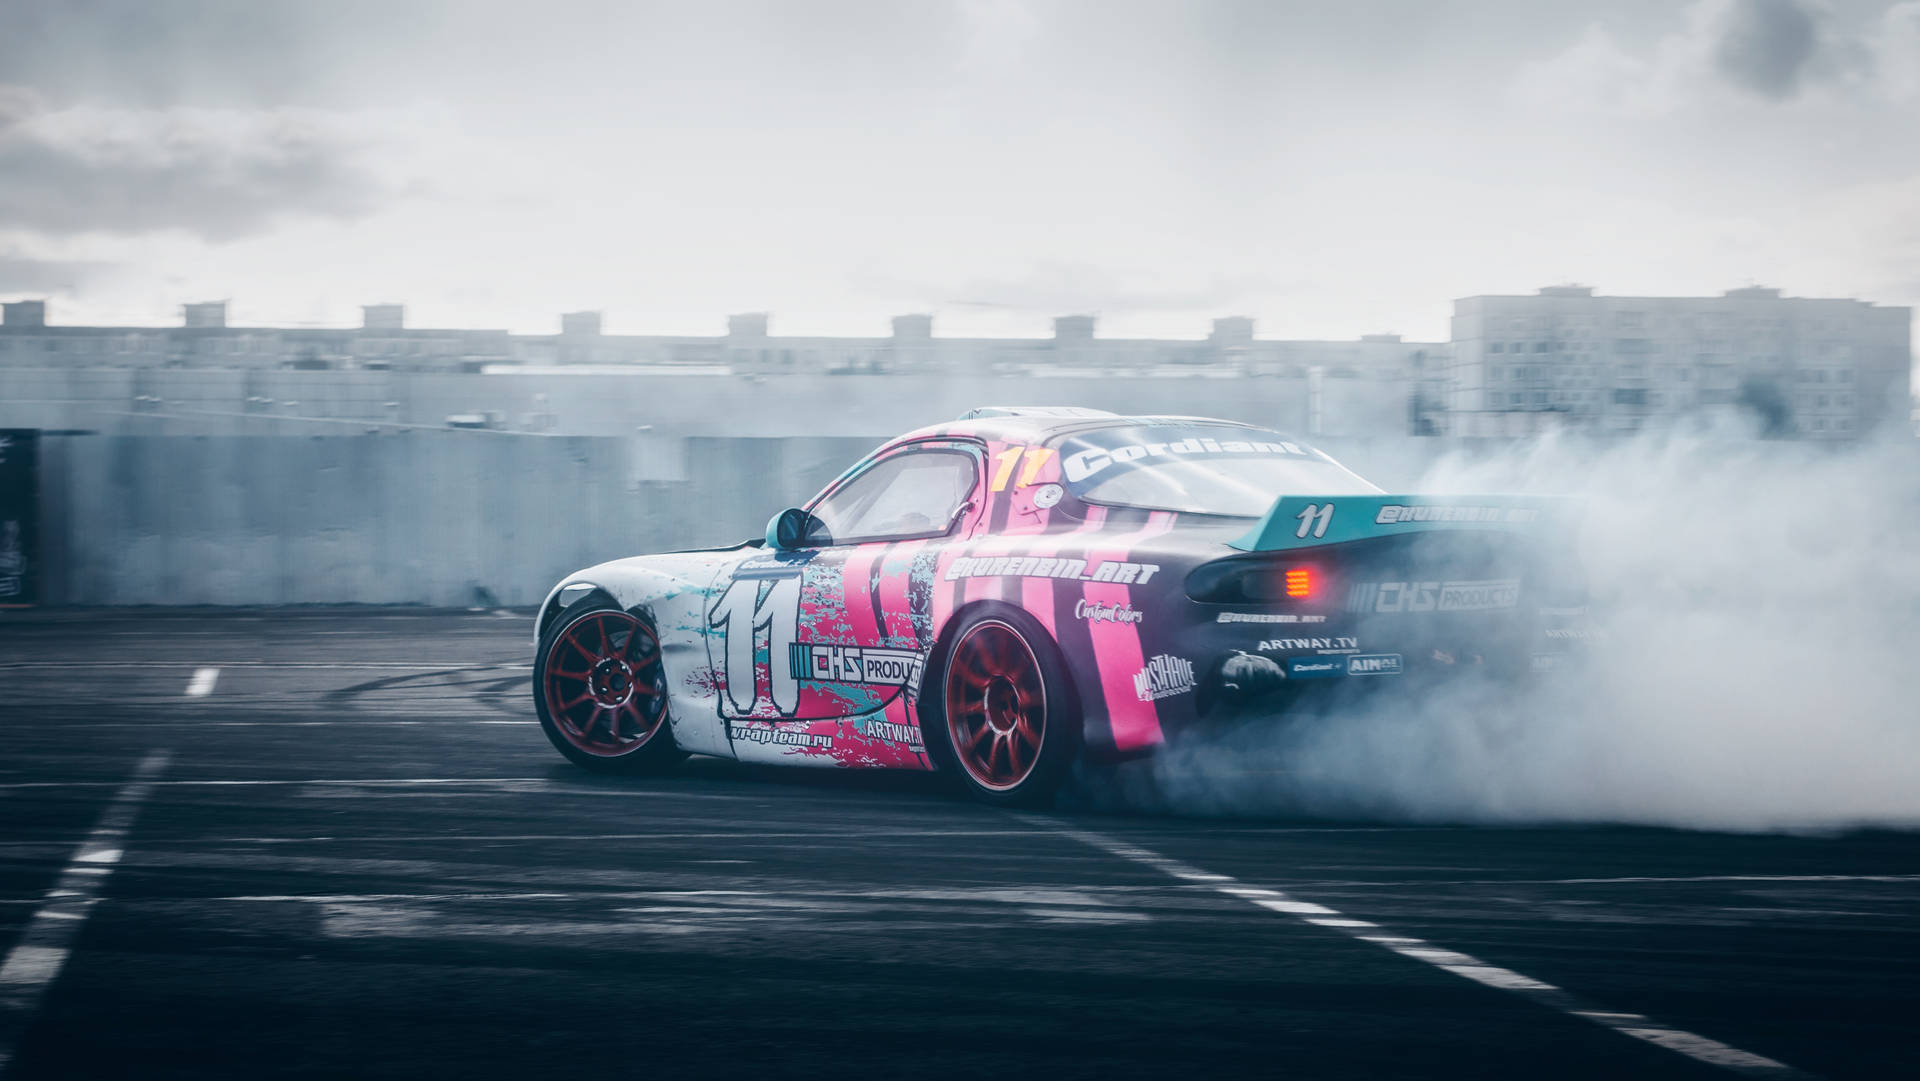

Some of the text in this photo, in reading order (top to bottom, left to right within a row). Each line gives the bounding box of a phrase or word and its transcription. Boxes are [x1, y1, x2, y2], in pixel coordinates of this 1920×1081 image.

[991, 447, 1055, 492] 11
[1063, 438, 1307, 483] Cordiant
[1296, 503, 1335, 538] 11
[1376, 581, 1440, 612] CHS
[709, 578, 803, 717] 11
[1258, 637, 1358, 651] ARTWAY.TV
[812, 646, 862, 682] CHS
